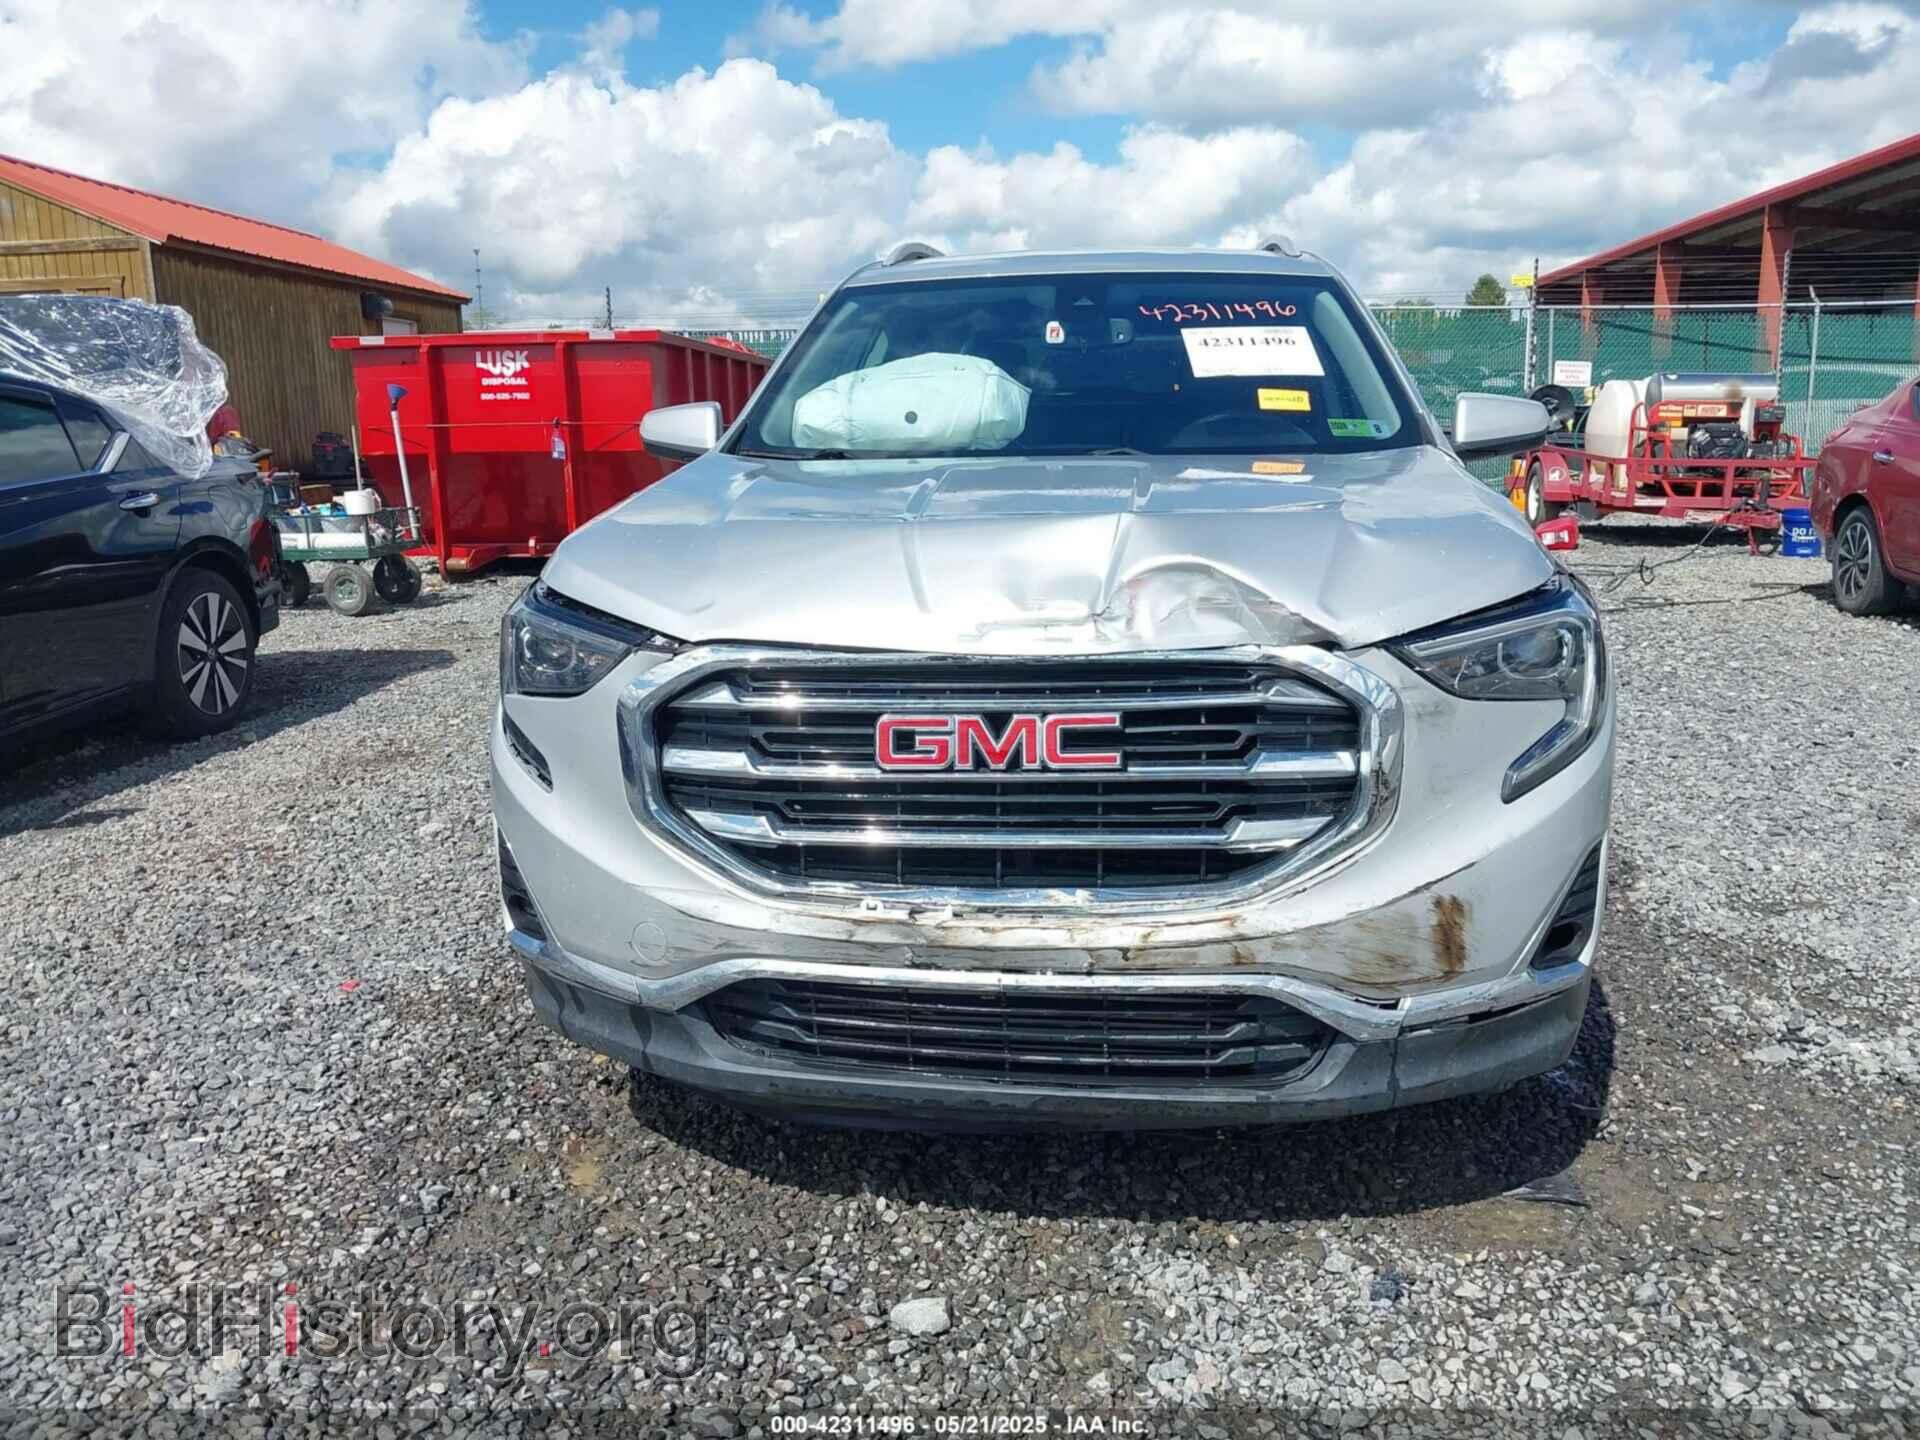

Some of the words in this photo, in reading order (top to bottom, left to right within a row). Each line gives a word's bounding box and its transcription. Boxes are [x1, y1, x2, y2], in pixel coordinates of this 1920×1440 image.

[1138, 300, 1297, 322] 42311496
[1198, 336, 1297, 348] 42311496
[475, 350, 530, 377] LUSK
[481, 377, 528, 386] DISPOSAL
[1792, 527, 1807, 537] DO
[875, 713, 1122, 771] GMC
